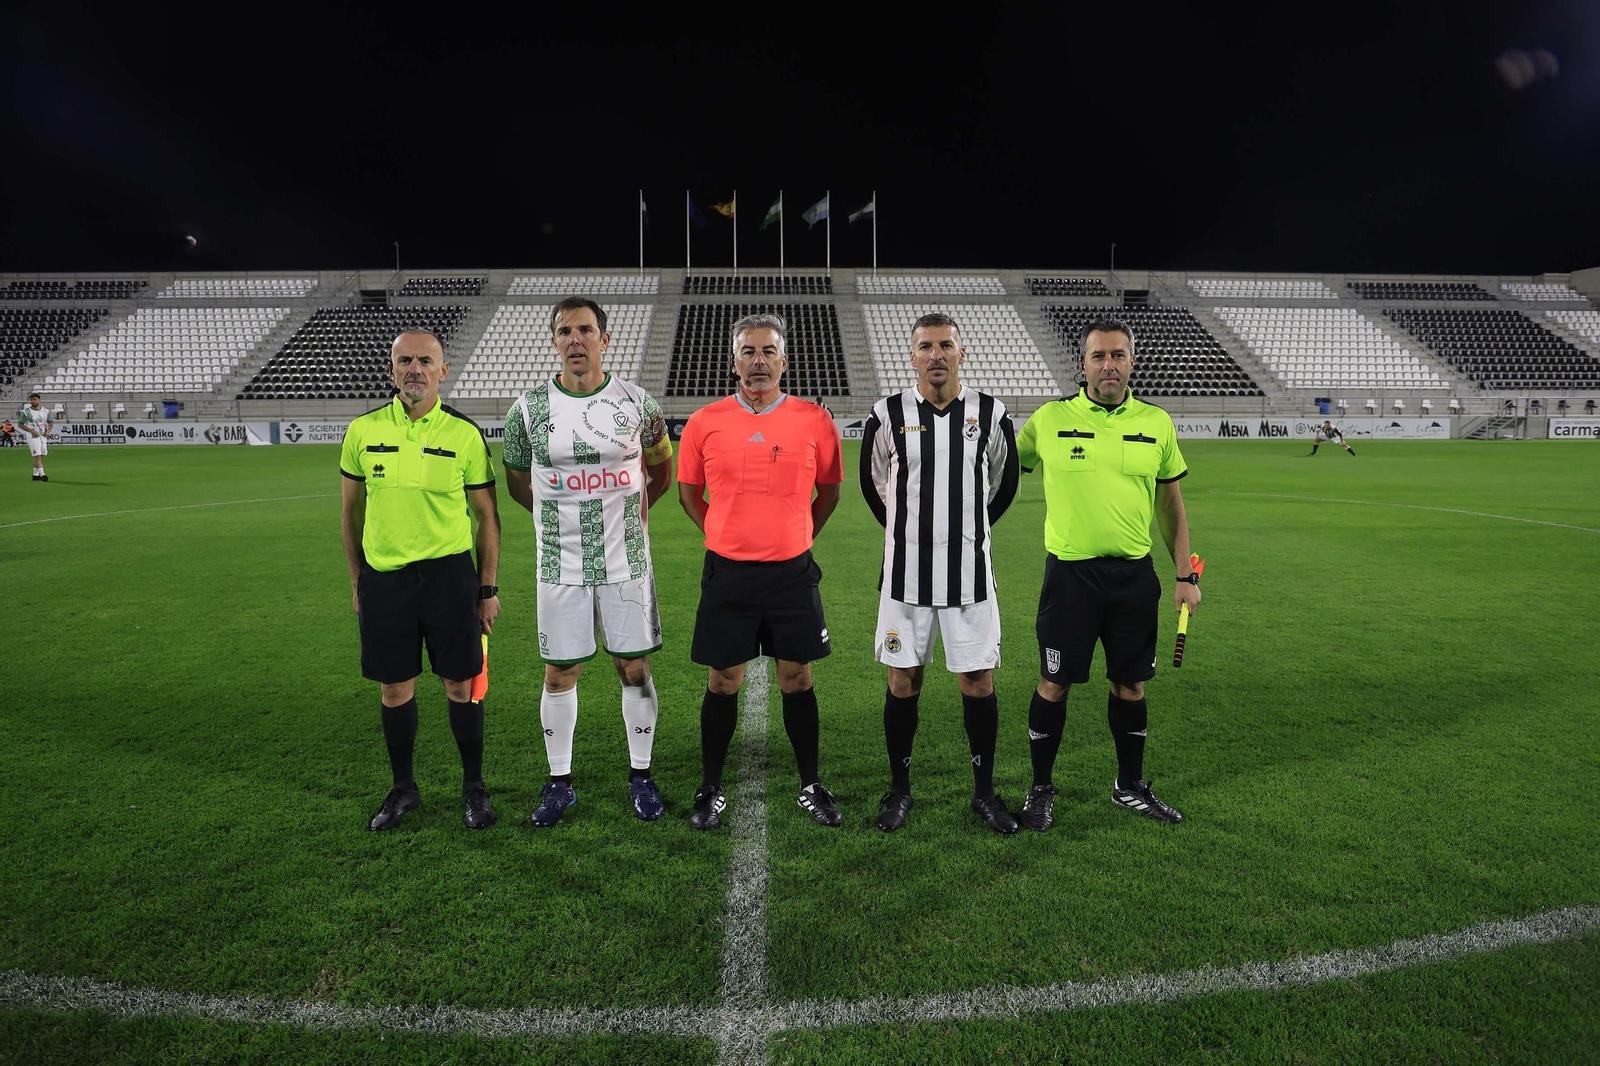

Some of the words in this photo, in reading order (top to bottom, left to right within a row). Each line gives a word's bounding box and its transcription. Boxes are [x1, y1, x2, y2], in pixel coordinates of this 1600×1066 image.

[72, 424, 125, 435] HARO-LAGO
[138, 428, 174, 438] Audika
[308, 424, 349, 433] SCIENTIF
[1218, 419, 1250, 438] MENA
[1258, 419, 1289, 438] MENA
[308, 433, 343, 441] NUTRITI
[566, 468, 631, 495] alpha
